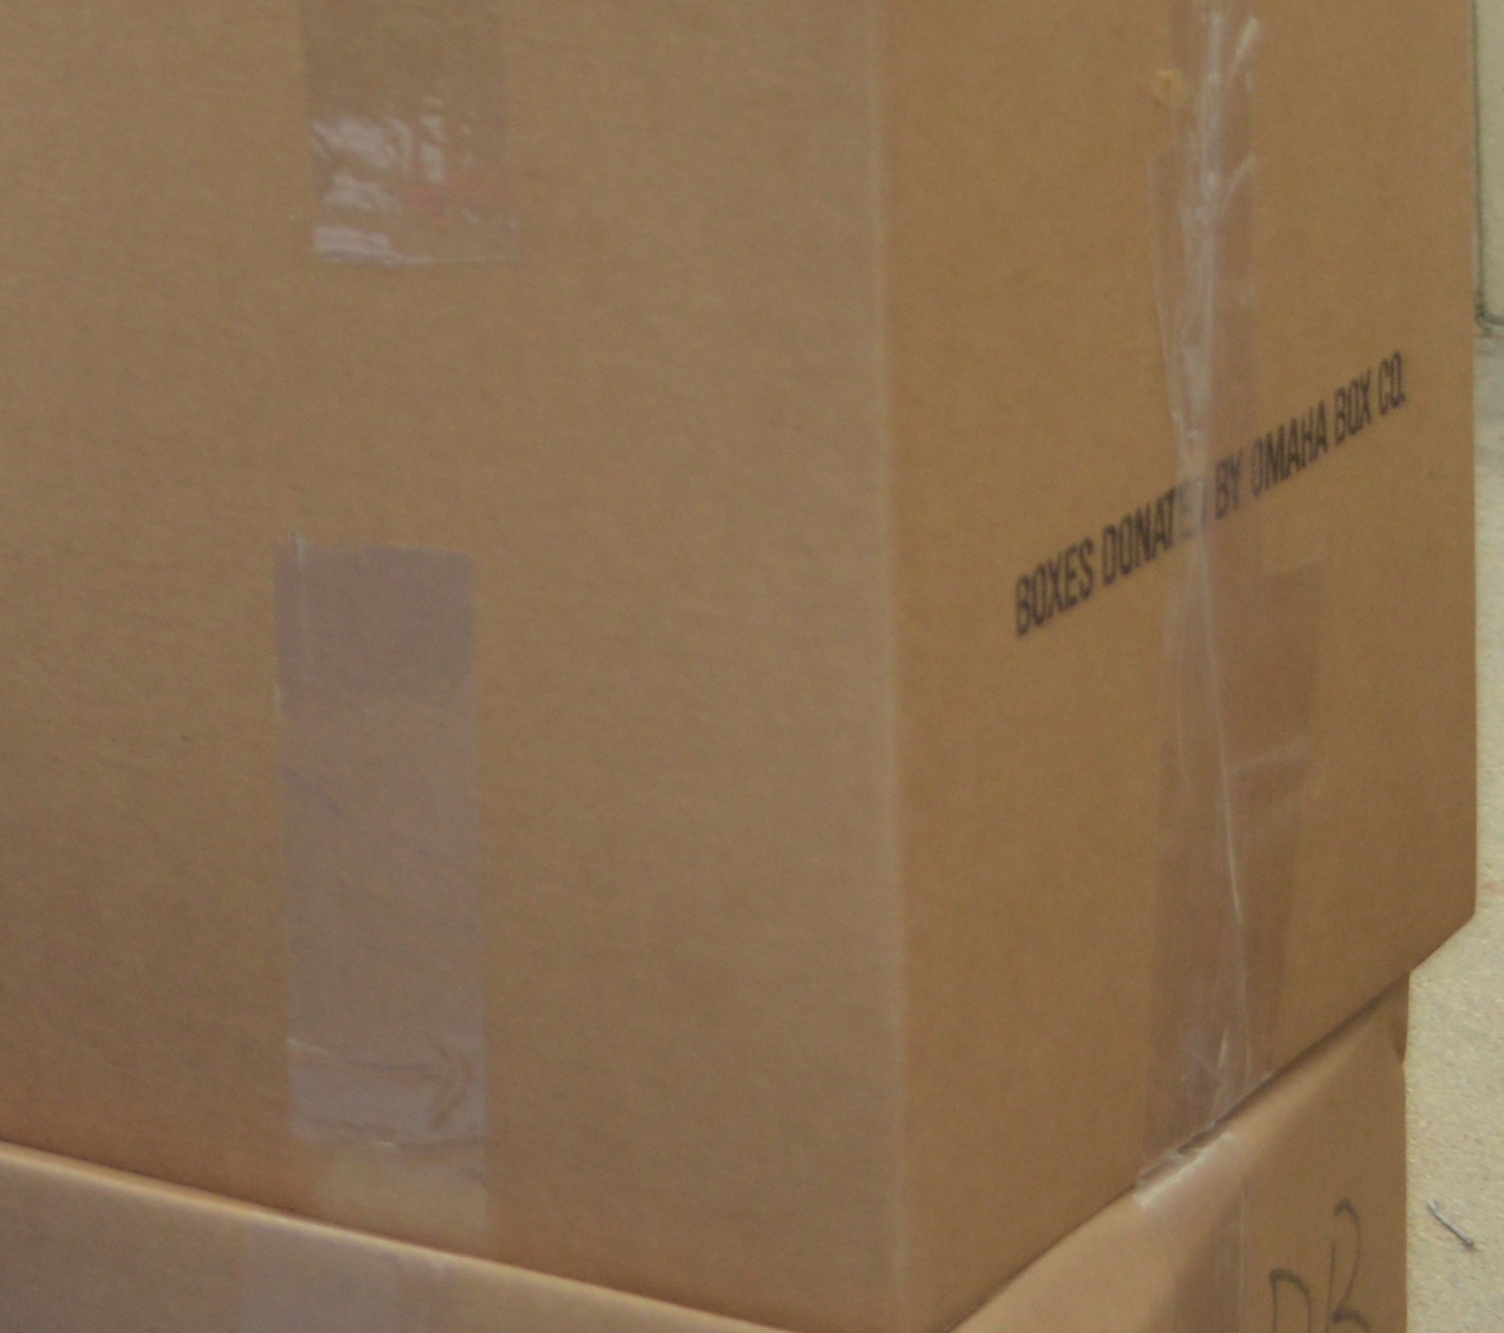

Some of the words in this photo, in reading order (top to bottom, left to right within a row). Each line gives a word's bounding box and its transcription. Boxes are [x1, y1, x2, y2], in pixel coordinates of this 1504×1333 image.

[1014, 536, 1095, 639] BOXES
[1101, 476, 1206, 588] DONATE
[1214, 449, 1245, 520] BY
[1250, 399, 1330, 498] OMAHA
[1333, 368, 1372, 447] BOX
